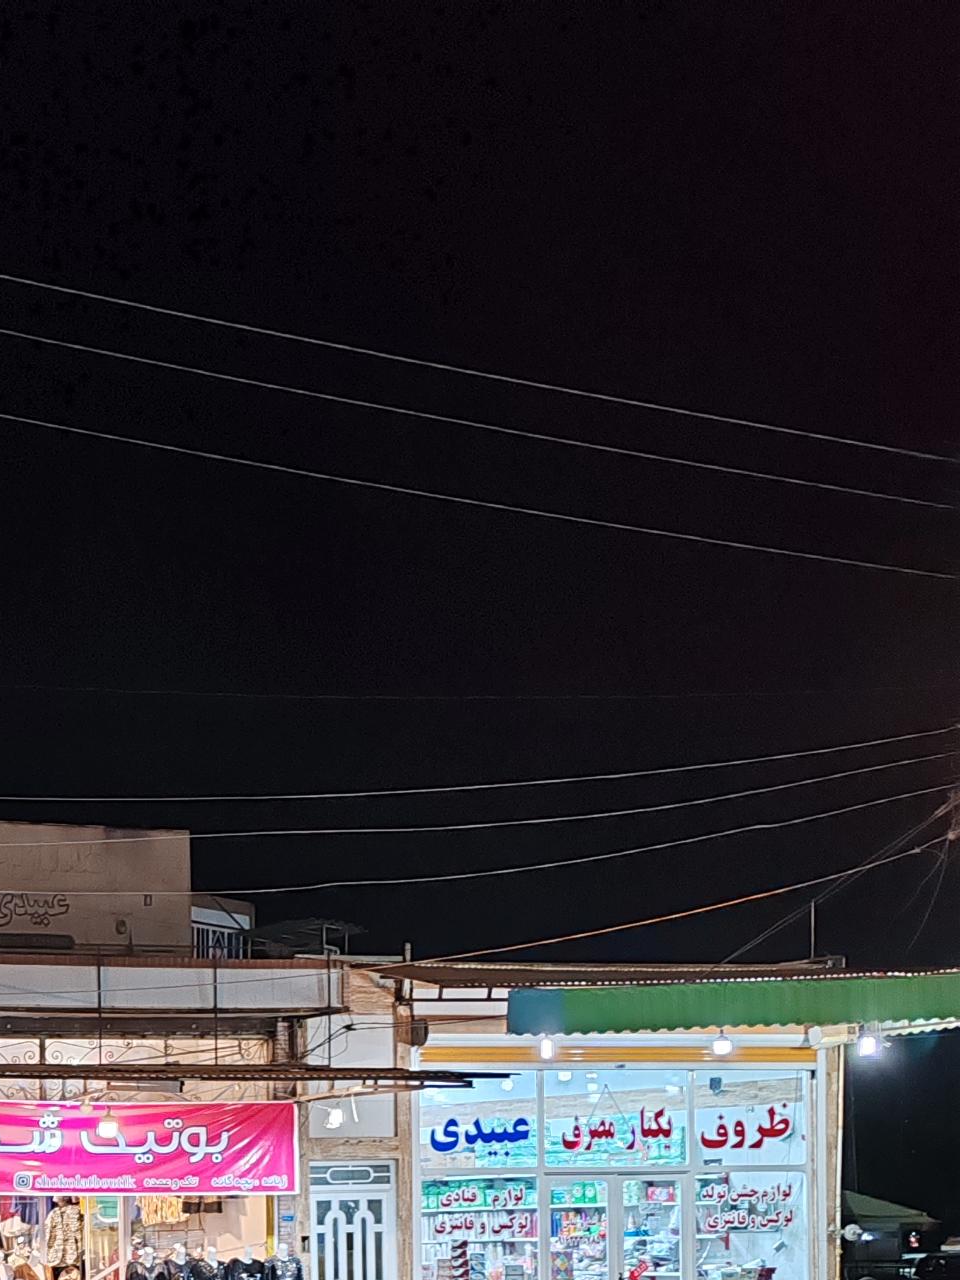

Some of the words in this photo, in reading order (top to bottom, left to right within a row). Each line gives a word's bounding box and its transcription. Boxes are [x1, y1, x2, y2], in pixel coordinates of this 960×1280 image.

[562, 1115, 614, 1151] مصرف
[626, 1106, 672, 1150] یکبار
[700, 1102, 790, 1149] ظروف
[80, 1118, 229, 1163] بوتیک
[430, 1116, 530, 1158] عبیدی
[441, 1187, 477, 1207] قنادی
[492, 1188, 523, 1209] لوازم
[701, 1184, 728, 1203] تولد
[759, 1183, 792, 1202] لوازم
[434, 1216, 474, 1234] فانتزی
[479, 1222, 486, 1234] و
[492, 1215, 528, 1234] لوکس
[707, 1210, 747, 1229] فانتزی
[759, 1210, 793, 1227] لوکس
